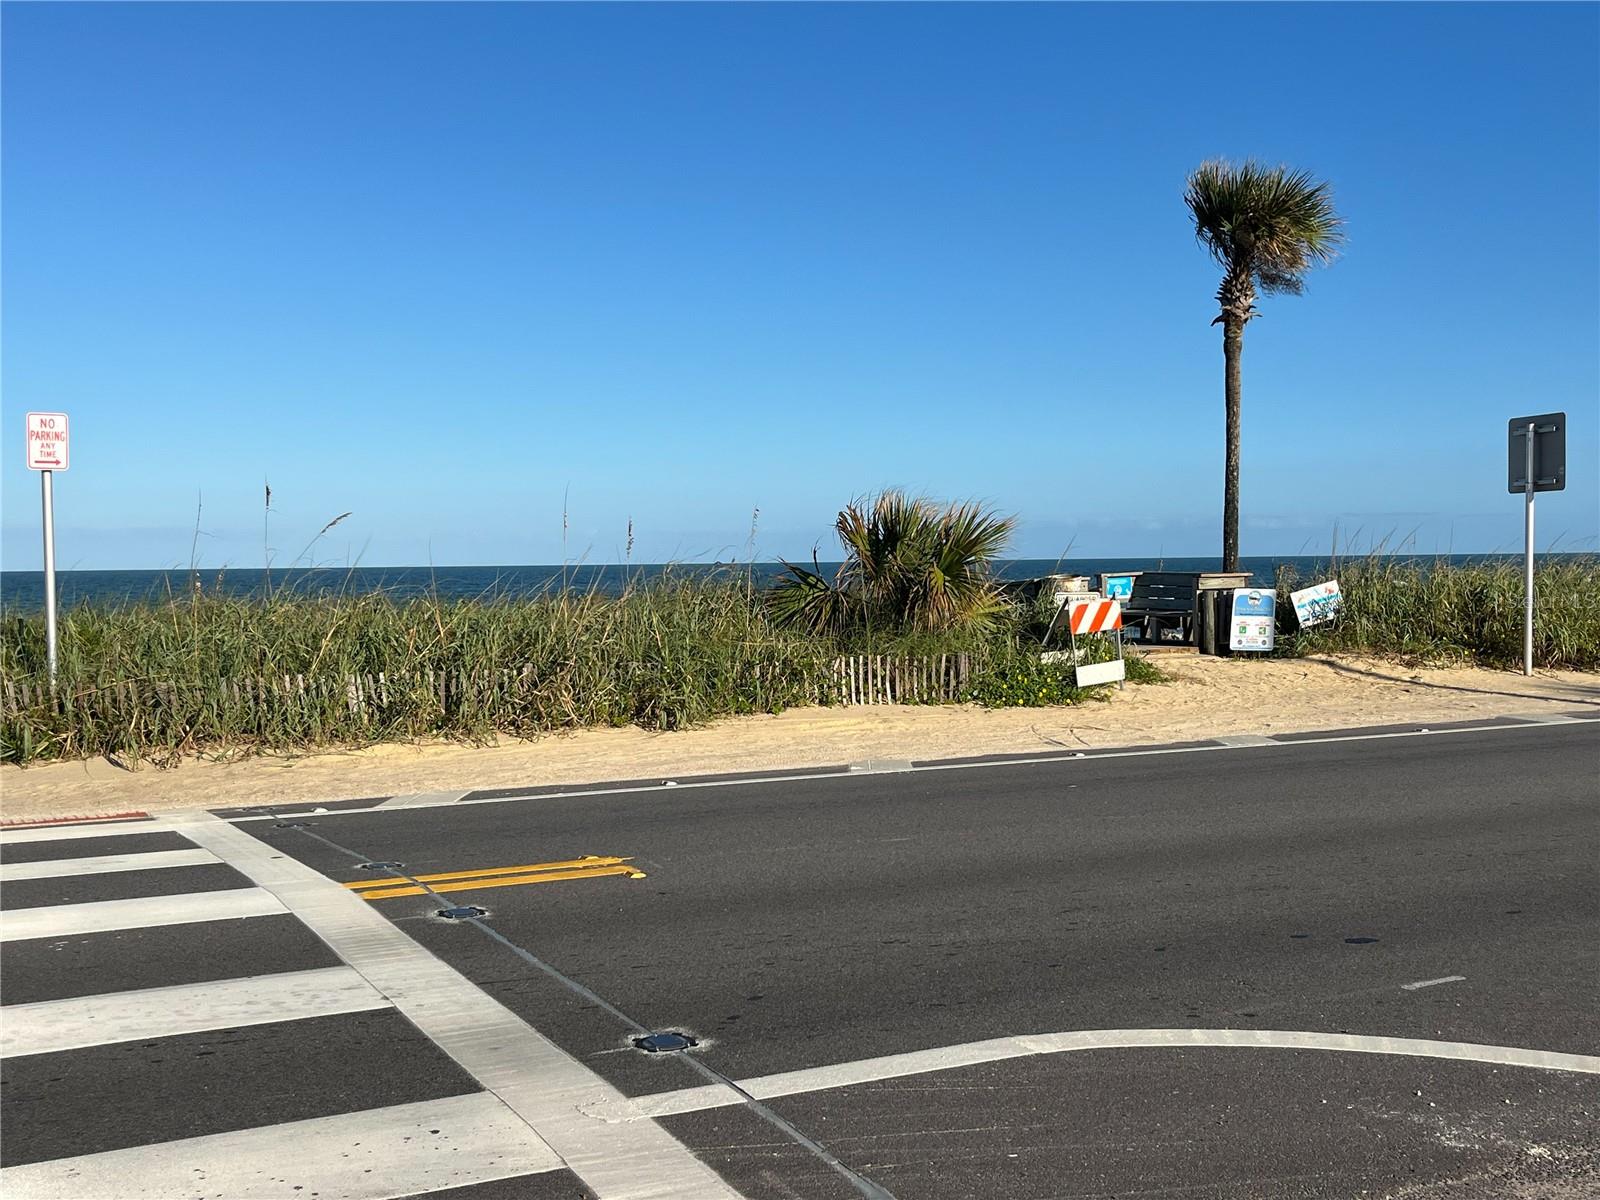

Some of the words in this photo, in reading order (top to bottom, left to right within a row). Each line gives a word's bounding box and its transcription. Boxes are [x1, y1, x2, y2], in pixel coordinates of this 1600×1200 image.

[40, 418, 55, 429] NO
[30, 430, 65, 442] PARKING
[40, 450, 57, 458] TIME
